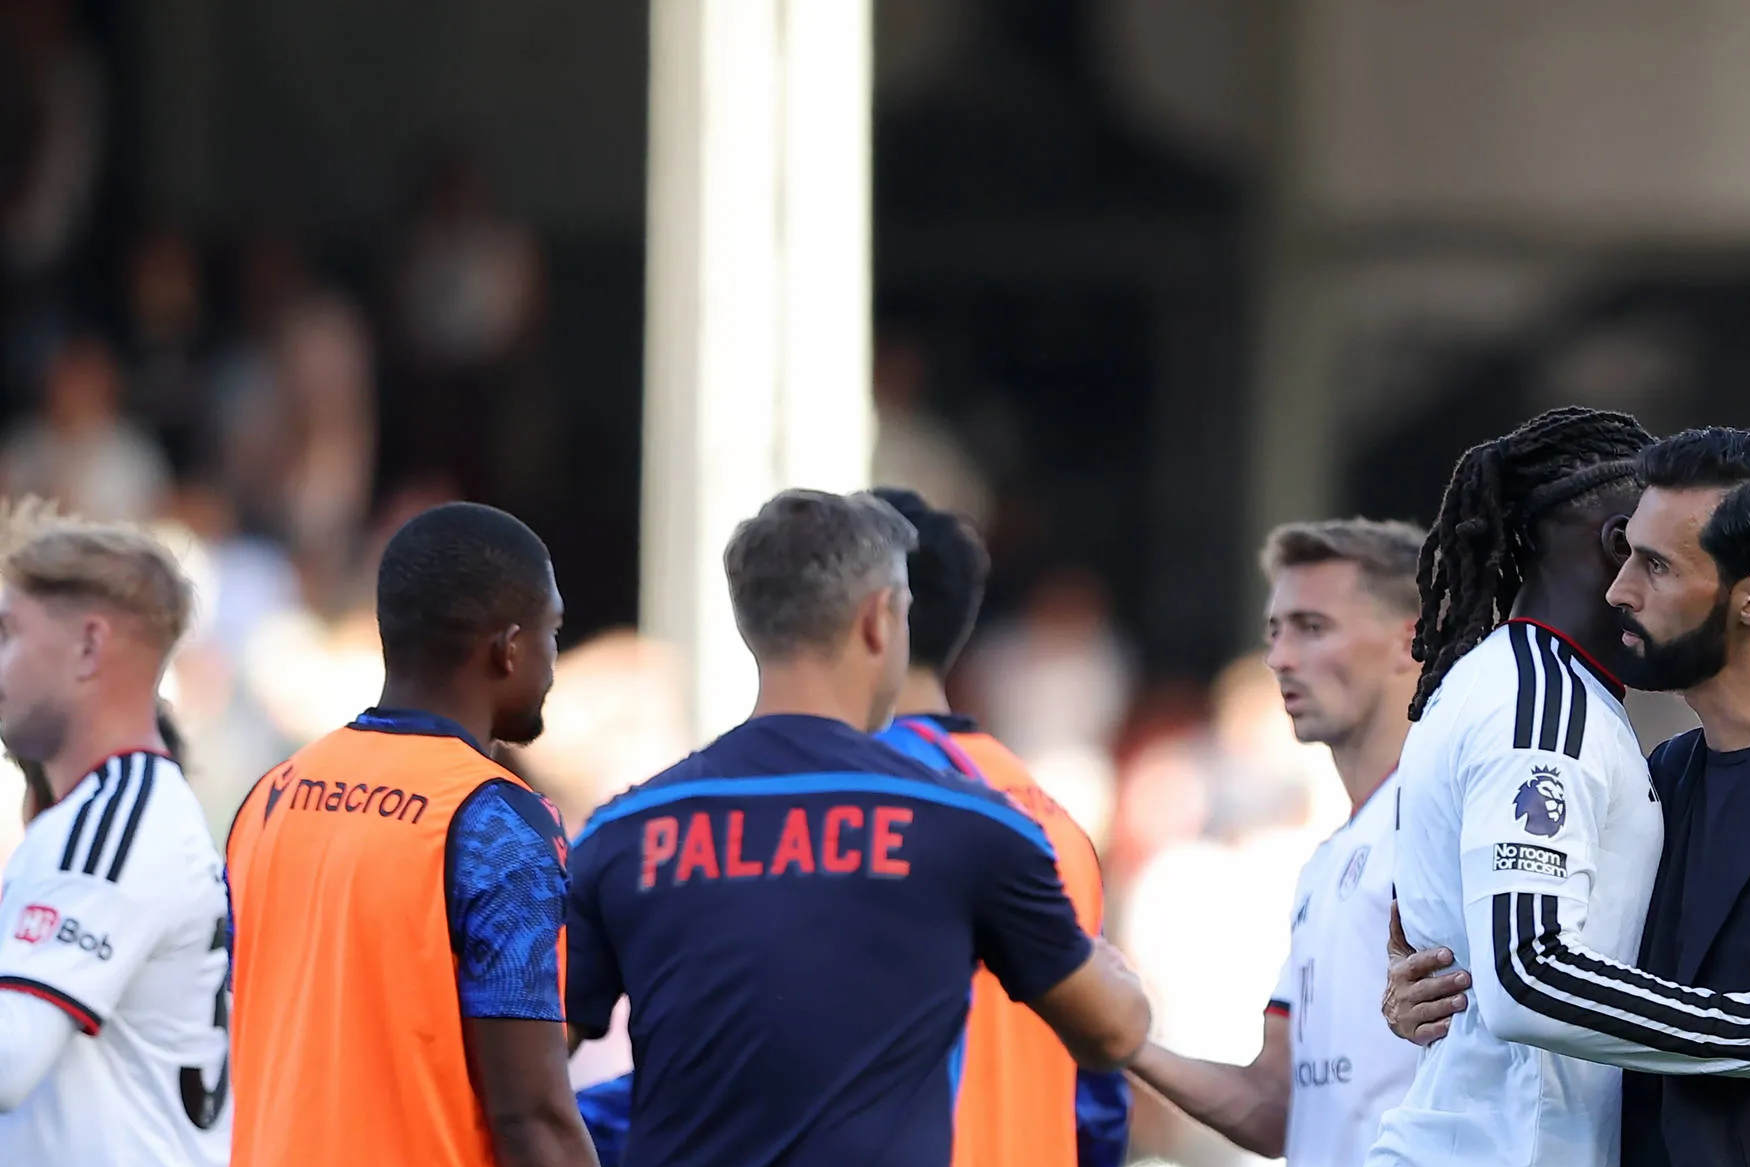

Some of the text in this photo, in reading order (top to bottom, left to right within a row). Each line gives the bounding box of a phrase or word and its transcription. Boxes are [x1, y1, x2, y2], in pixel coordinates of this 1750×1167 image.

[290, 778, 429, 825] macron
[640, 804, 914, 888] PALACE
[1494, 843, 1561, 866] No room
[1518, 859, 1567, 878] racism
